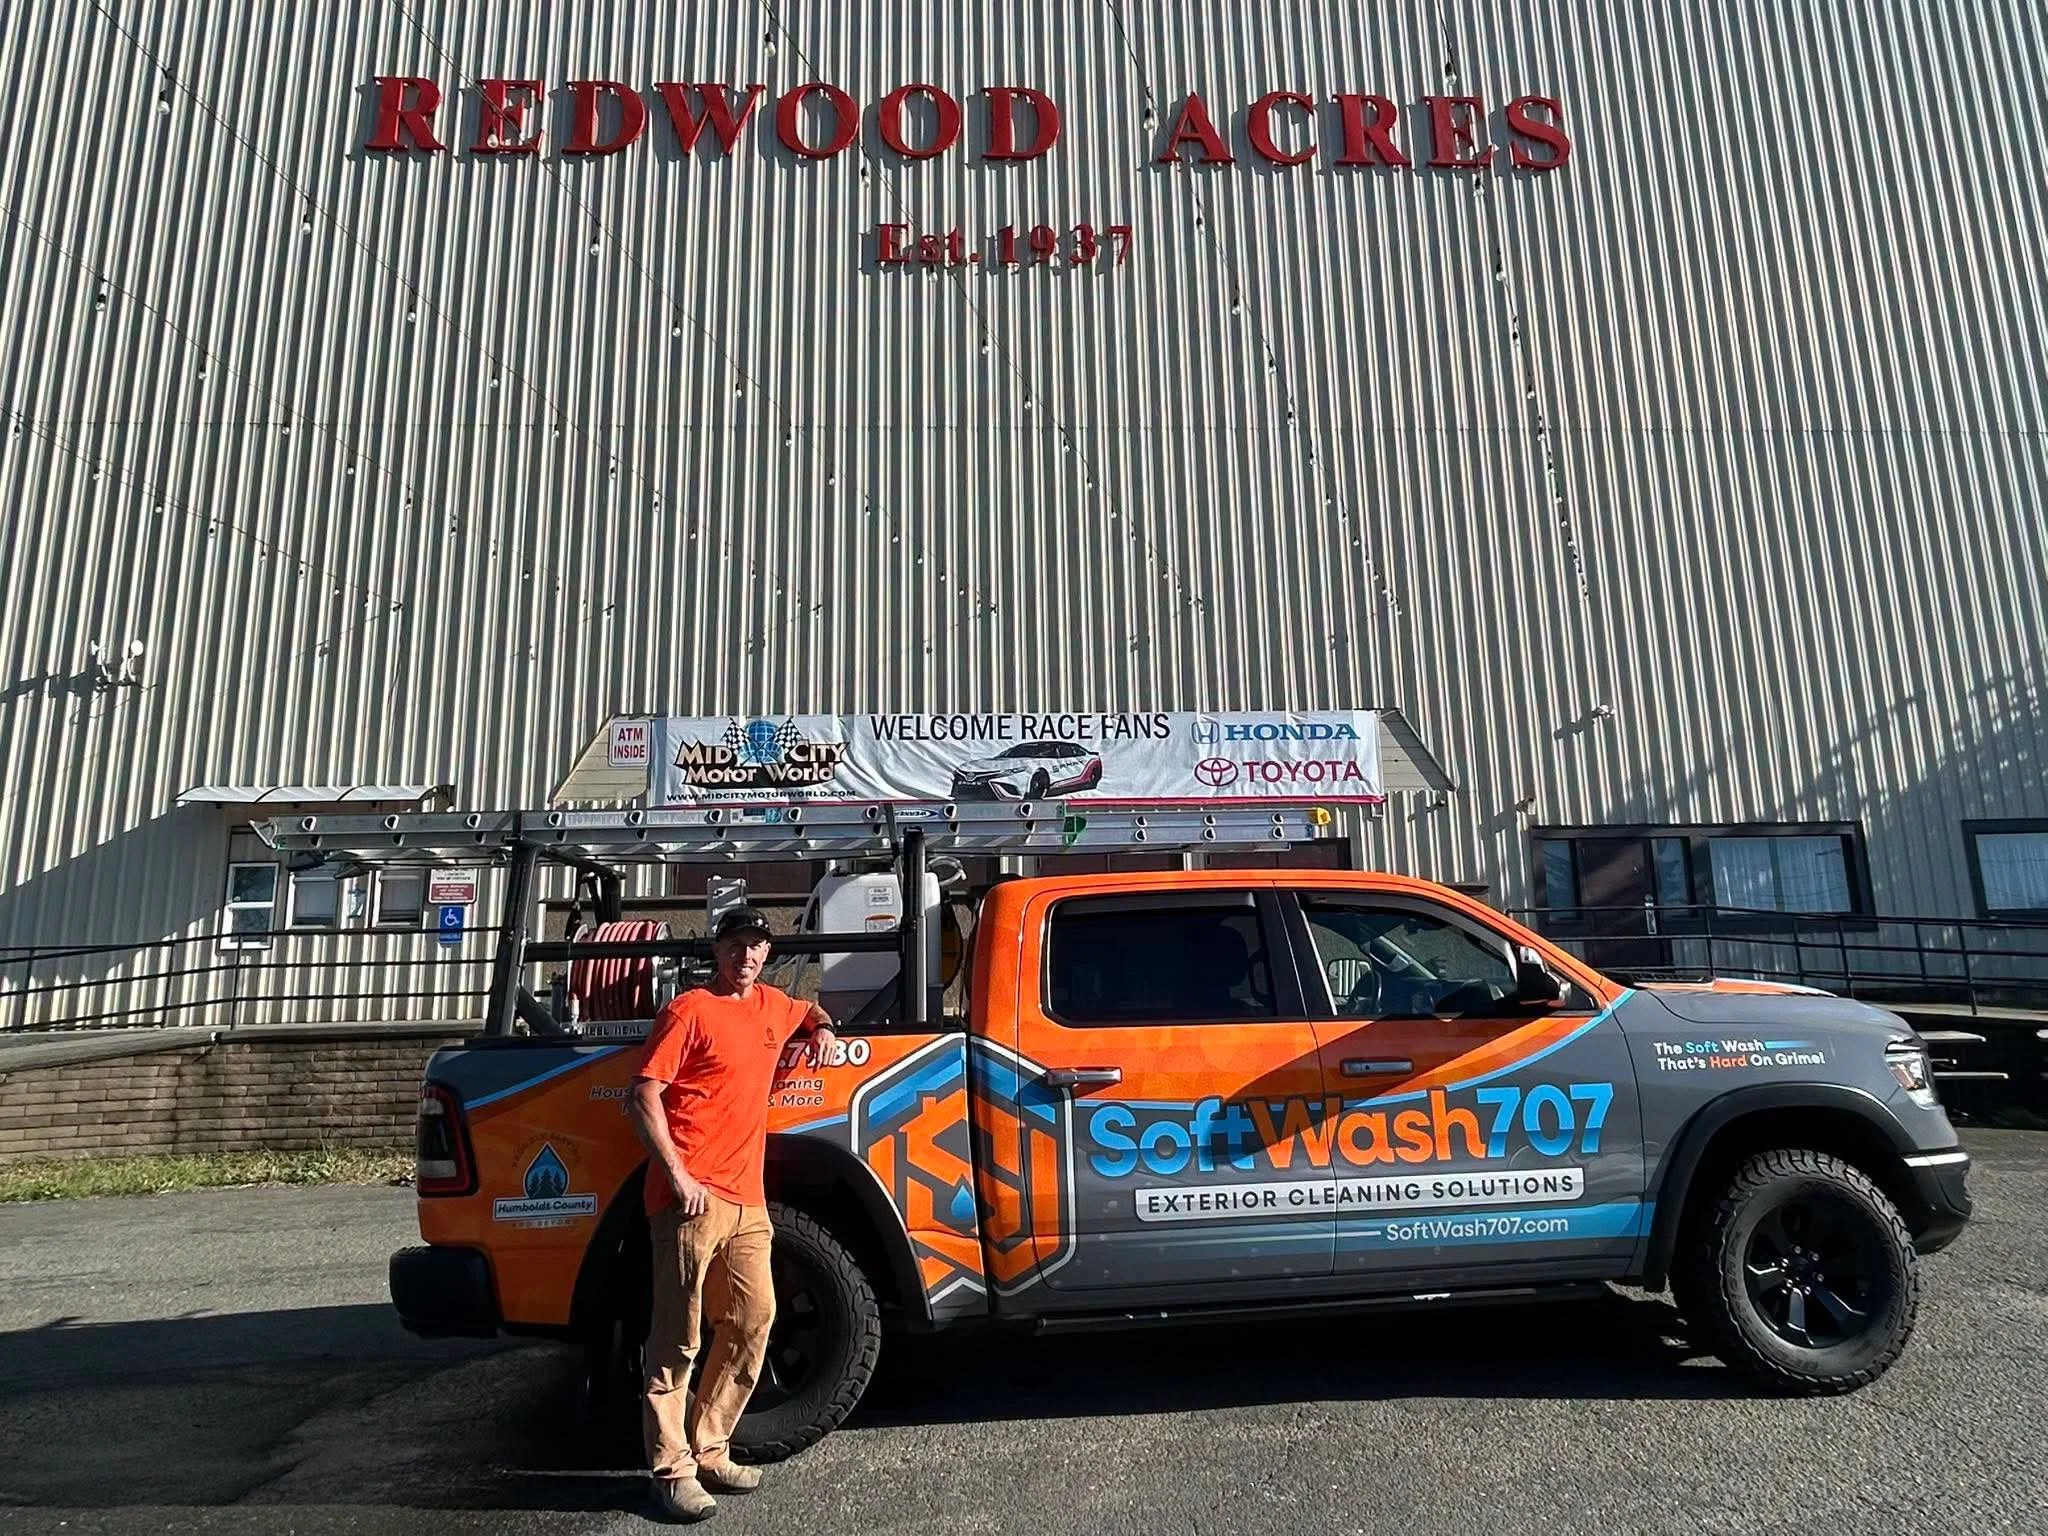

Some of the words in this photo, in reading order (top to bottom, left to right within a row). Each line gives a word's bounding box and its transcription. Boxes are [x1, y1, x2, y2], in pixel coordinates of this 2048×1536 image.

[364, 76, 1061, 160] REDWOOD
[1159, 91, 1571, 170] ACRES
[876, 223, 980, 266] Est.
[999, 223, 1132, 266] 1937
[618, 728, 643, 741] ATM
[870, 714, 1011, 740] WELCOME
[1020, 714, 1092, 740] RACE
[1100, 713, 1171, 740] FANS
[1224, 723, 1361, 741] HONDA
[614, 745, 645, 759] INSIDE
[675, 741, 730, 765] MID
[788, 740, 846, 763] CITY
[685, 765, 757, 784] Motor
[764, 762, 834, 782] World
[1242, 760, 1364, 783] TOYOTA
[1653, 1042, 1683, 1055] The
[1685, 1041, 1719, 1053] Soft
[1721, 1039, 1765, 1053] Wash
[1657, 1056, 1706, 1070] That's
[1709, 1055, 1748, 1068] Hard
[1750, 1053, 1773, 1066] On
[1775, 1051, 1826, 1065] Grime!
[782, 1095, 823, 1106] More
[1089, 1082, 1614, 1177] SoftWash707
[1148, 1189, 1277, 1213] EXTERIOR
[1288, 1183, 1421, 1206] CLEANING
[1432, 1175, 1574, 1198] SOLUTIONS
[497, 1202, 550, 1213] Humboldt
[553, 1200, 592, 1210] County
[1386, 1217, 1569, 1241] SoftWash707.com
